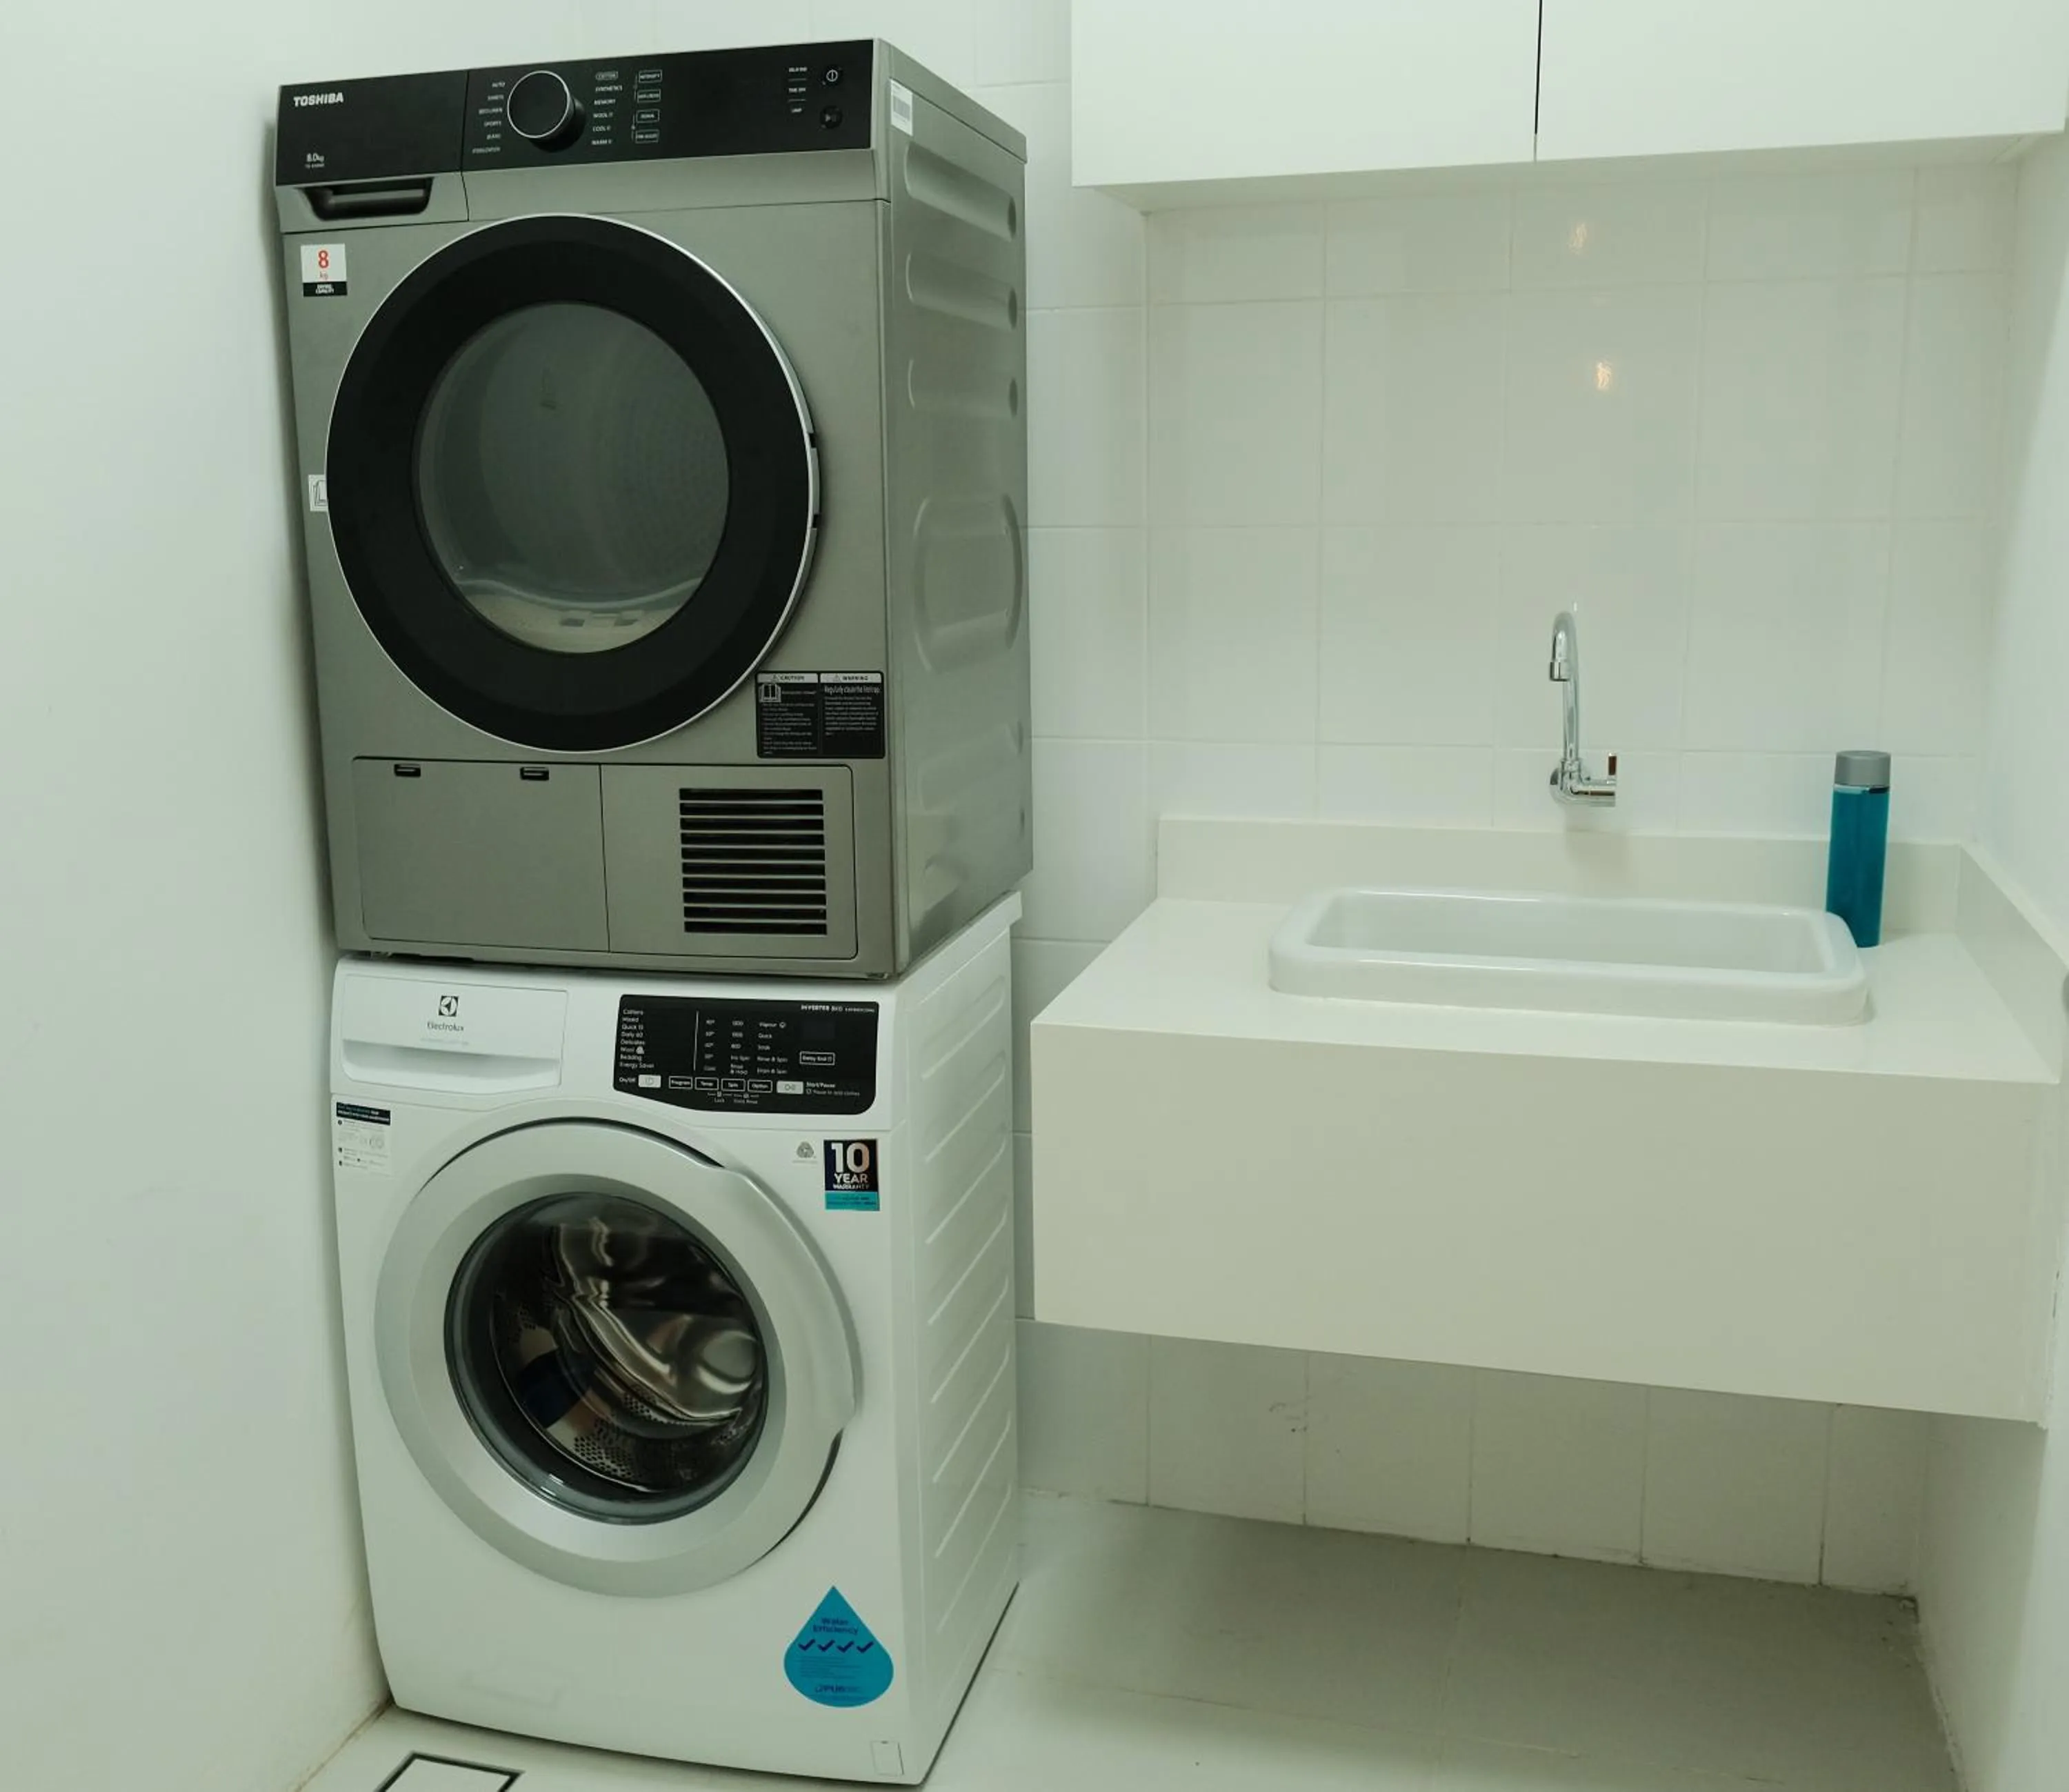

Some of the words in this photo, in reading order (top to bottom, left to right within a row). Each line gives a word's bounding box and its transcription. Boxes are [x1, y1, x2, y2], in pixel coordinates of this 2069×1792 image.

[293, 92, 344, 108] TOSHIBA
[318, 250, 329, 268] 8
[427, 1021, 464, 1032] Electrolux
[831, 1142, 870, 1173] 10
[834, 1173, 868, 1184] YEAR
[812, 1624, 859, 1635] Efficiency
